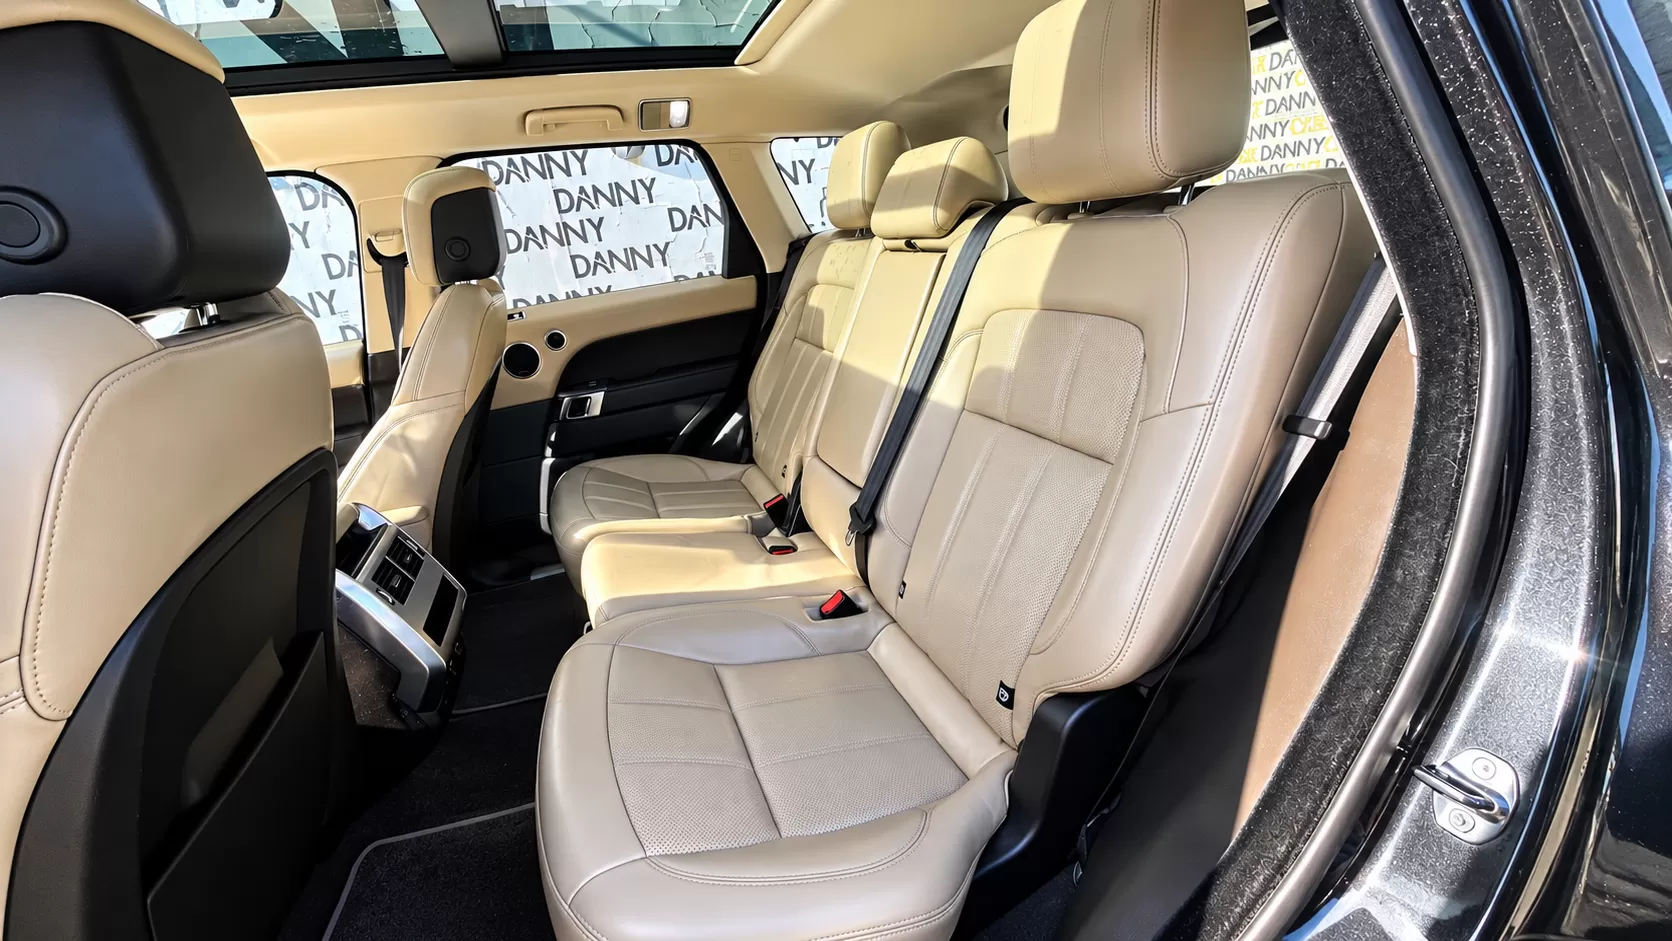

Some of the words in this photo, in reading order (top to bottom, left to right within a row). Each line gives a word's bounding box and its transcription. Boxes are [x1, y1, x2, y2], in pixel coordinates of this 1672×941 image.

[1251, 70, 1296, 95] NNY
[1247, 119, 1290, 142] NNY
[1260, 136, 1326, 161] DANNY
[481, 149, 588, 186] DANNY
[553, 177, 656, 214] DANNY
[504, 216, 604, 254] DANNY
[569, 241, 670, 279] DANNY
